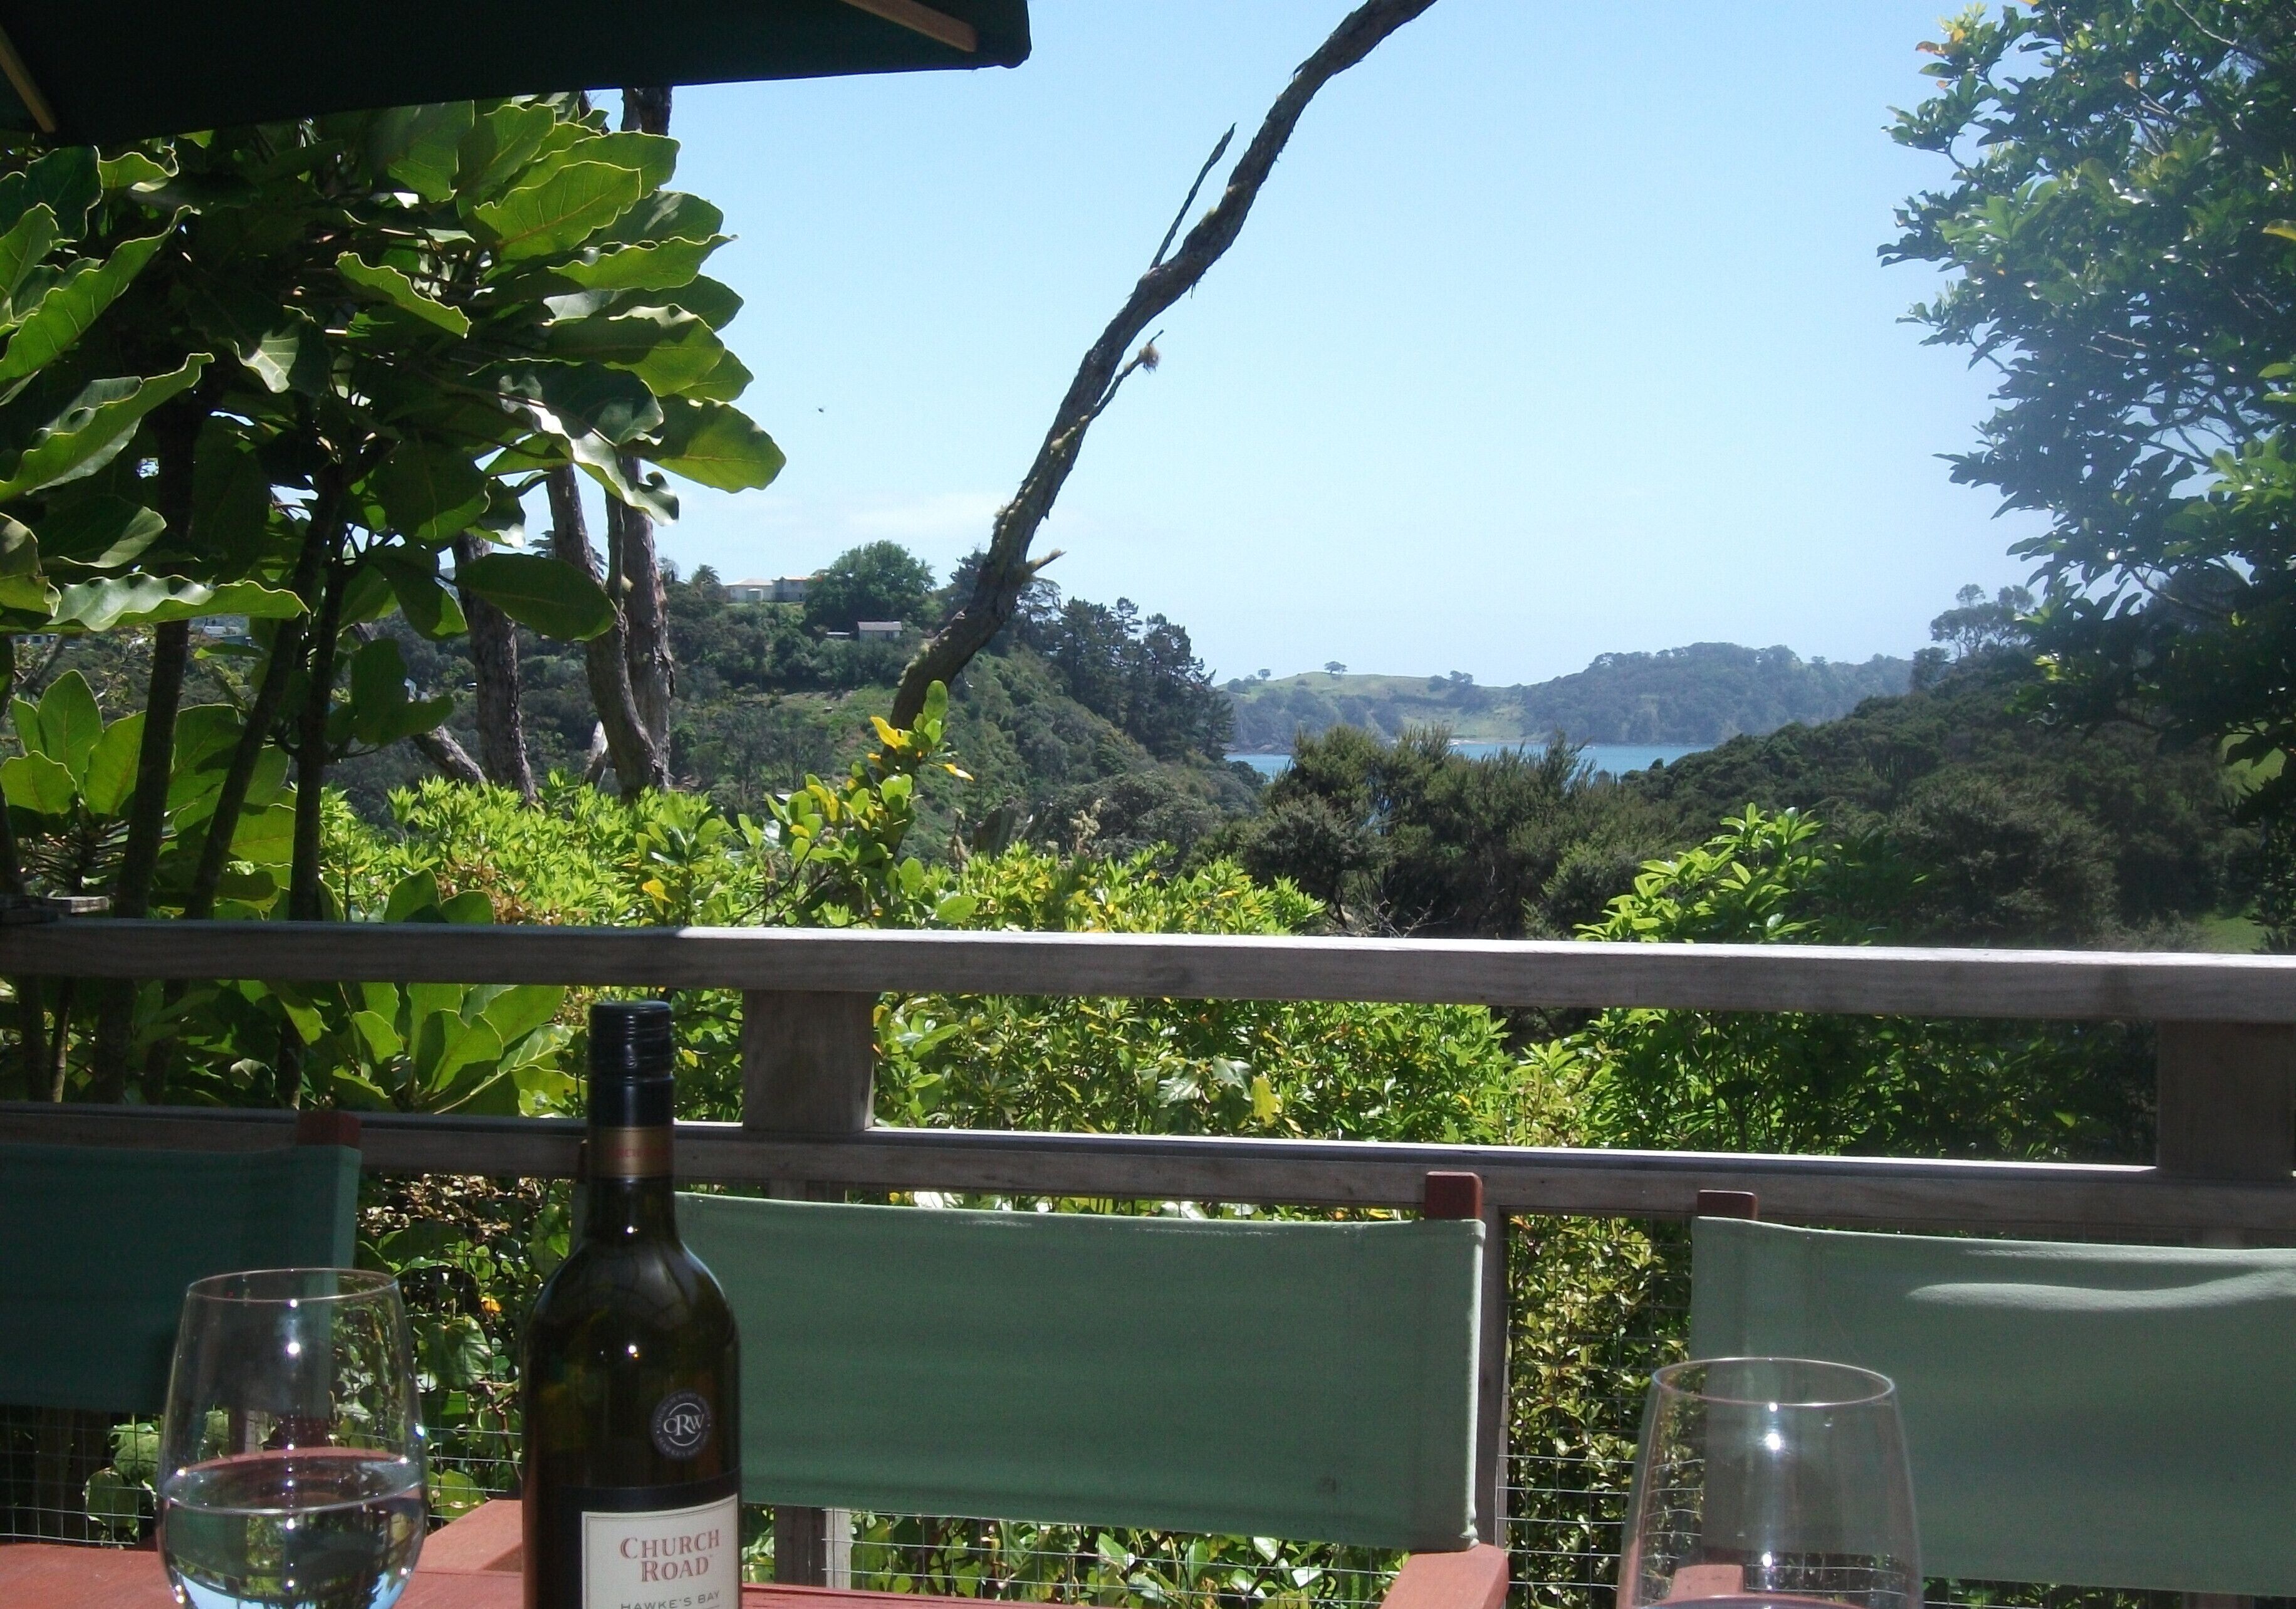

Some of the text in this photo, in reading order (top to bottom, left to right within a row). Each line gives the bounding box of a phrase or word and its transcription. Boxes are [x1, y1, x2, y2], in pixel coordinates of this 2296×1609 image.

[620, 1529, 720, 1559] CHURCH
[642, 1556, 709, 1582] ROAD
[697, 1589, 721, 1603] BAY
